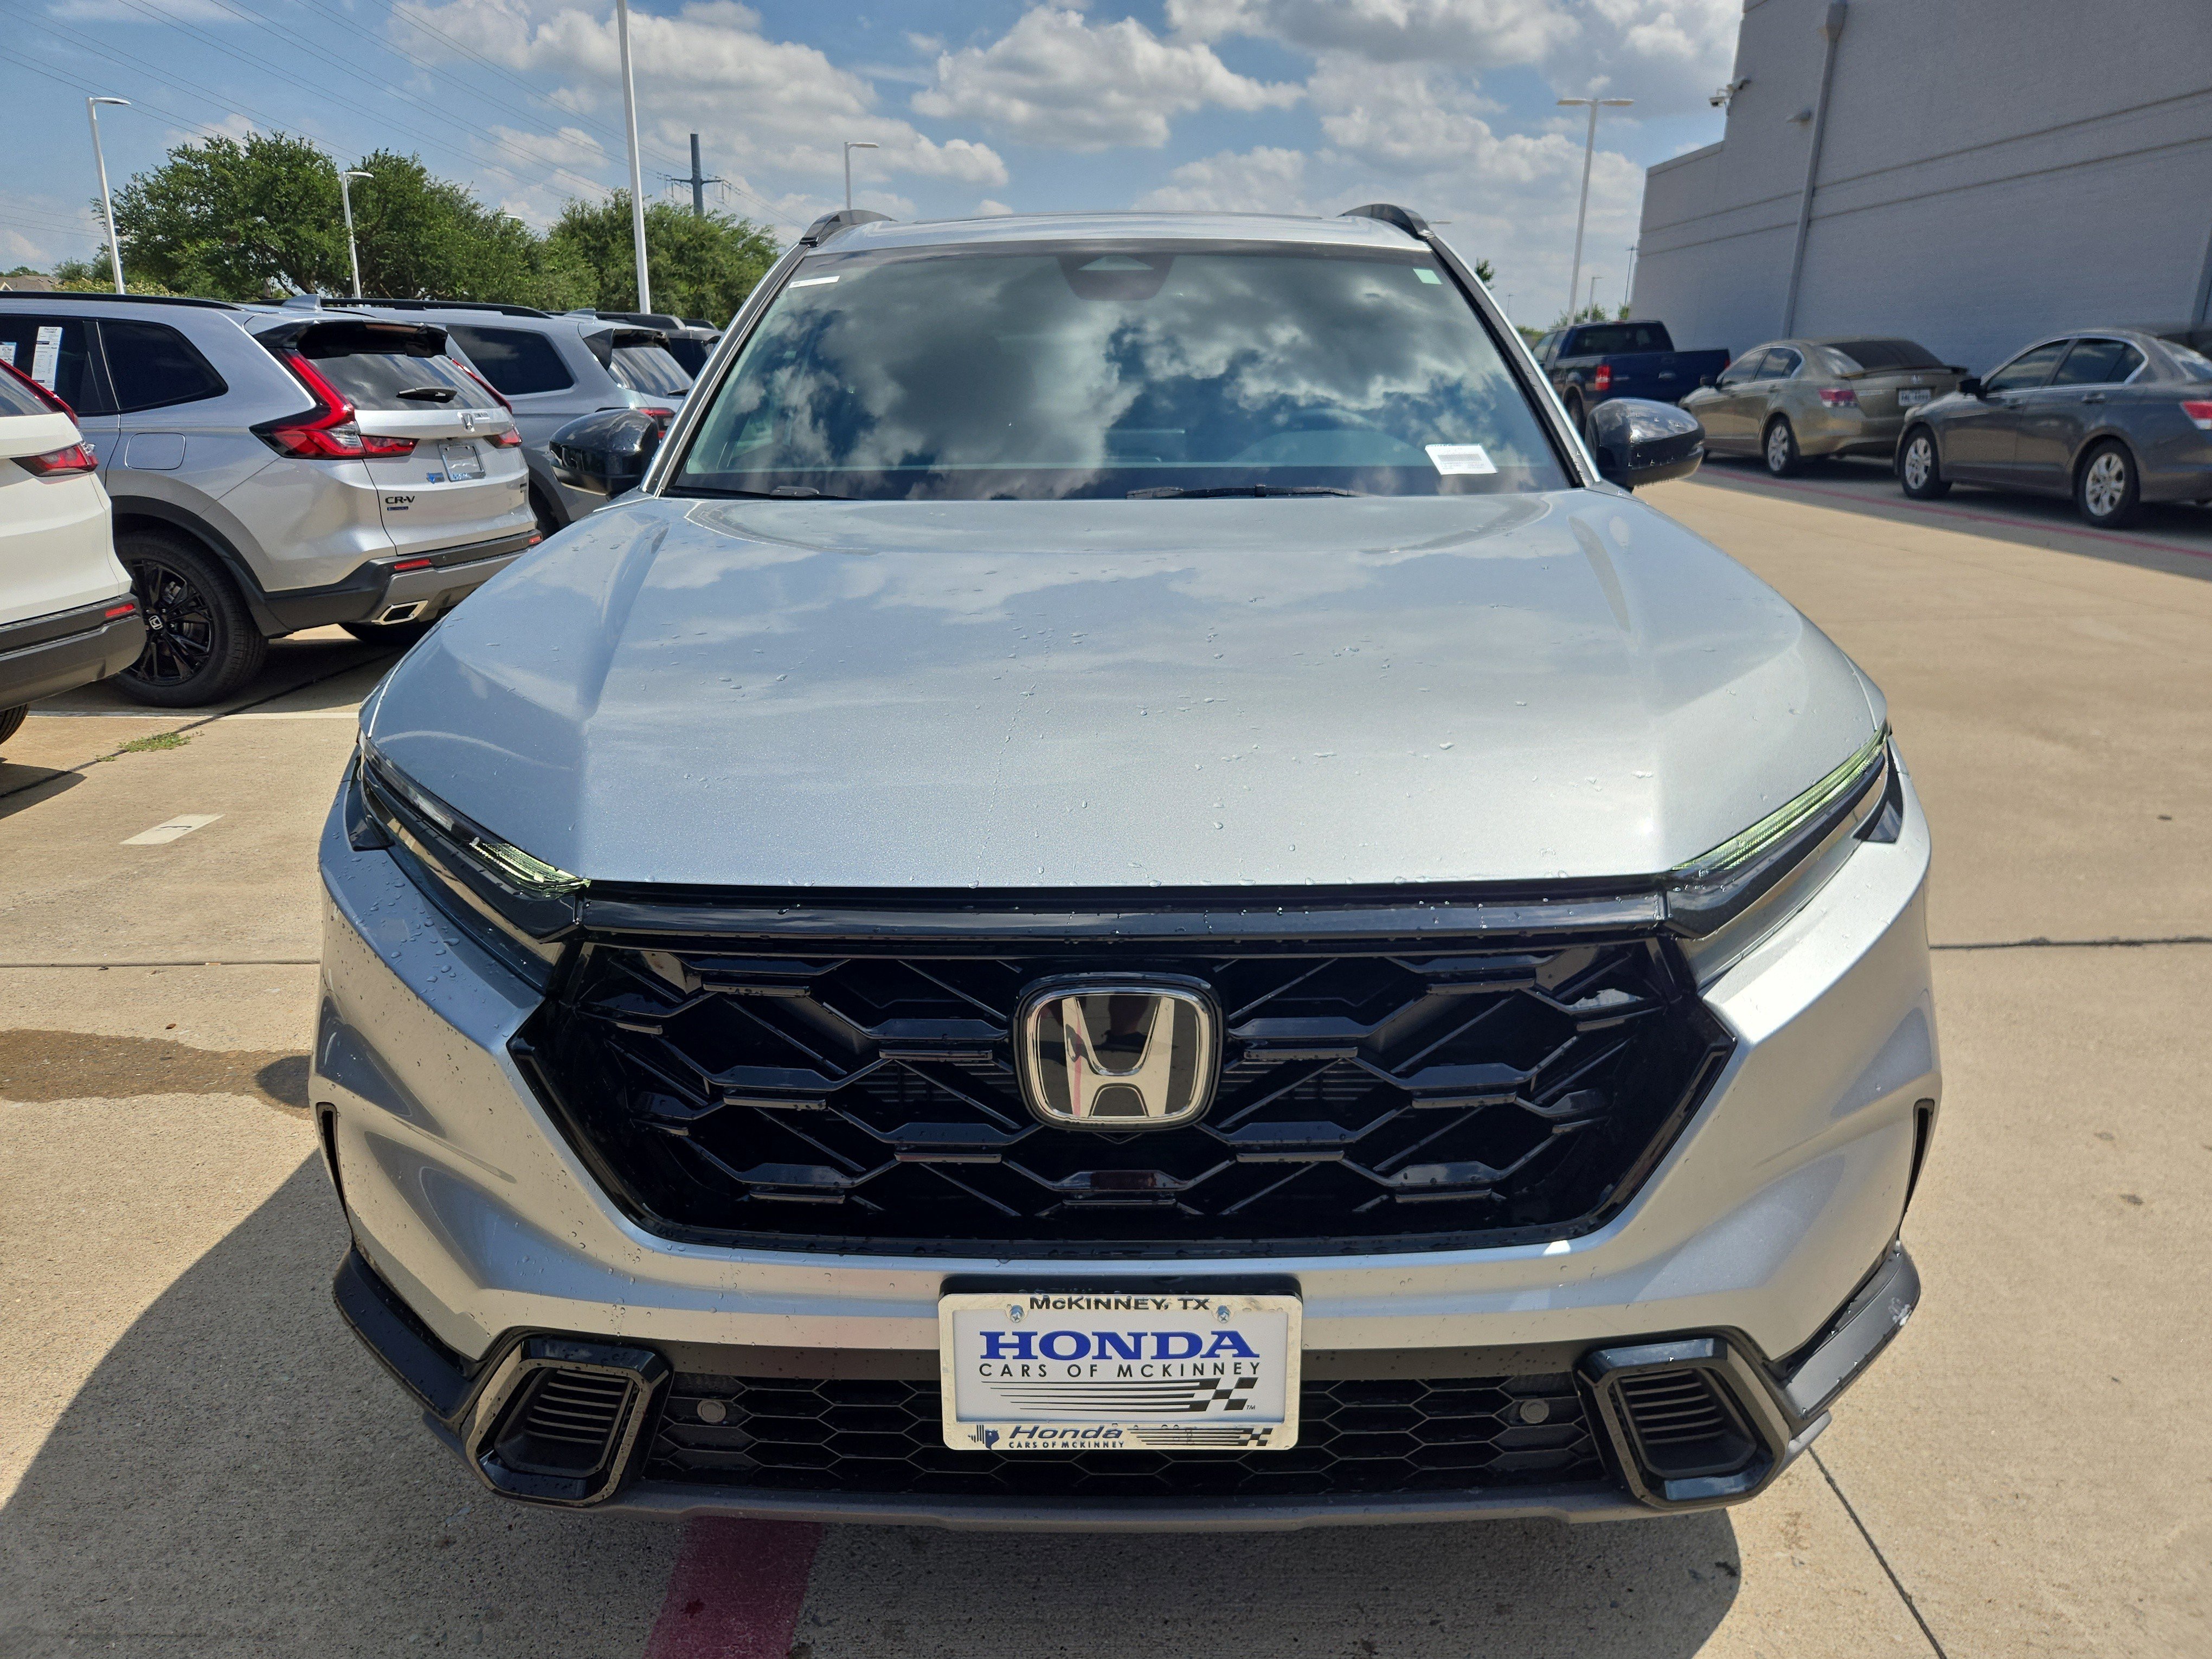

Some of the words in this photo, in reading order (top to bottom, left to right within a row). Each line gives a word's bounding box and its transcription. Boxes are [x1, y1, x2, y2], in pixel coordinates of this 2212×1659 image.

[385, 496, 415, 504] CR-V
[1030, 1296, 1169, 1310] McKINNEY,
[1177, 1297, 1211, 1310] TX
[980, 1330, 1260, 1360] HONDA
[979, 1363, 1047, 1378] CARS
[1066, 1364, 1098, 1378] OF
[1117, 1361, 1261, 1378] MCKINNEY
[1008, 1425, 1123, 1439] Honda
